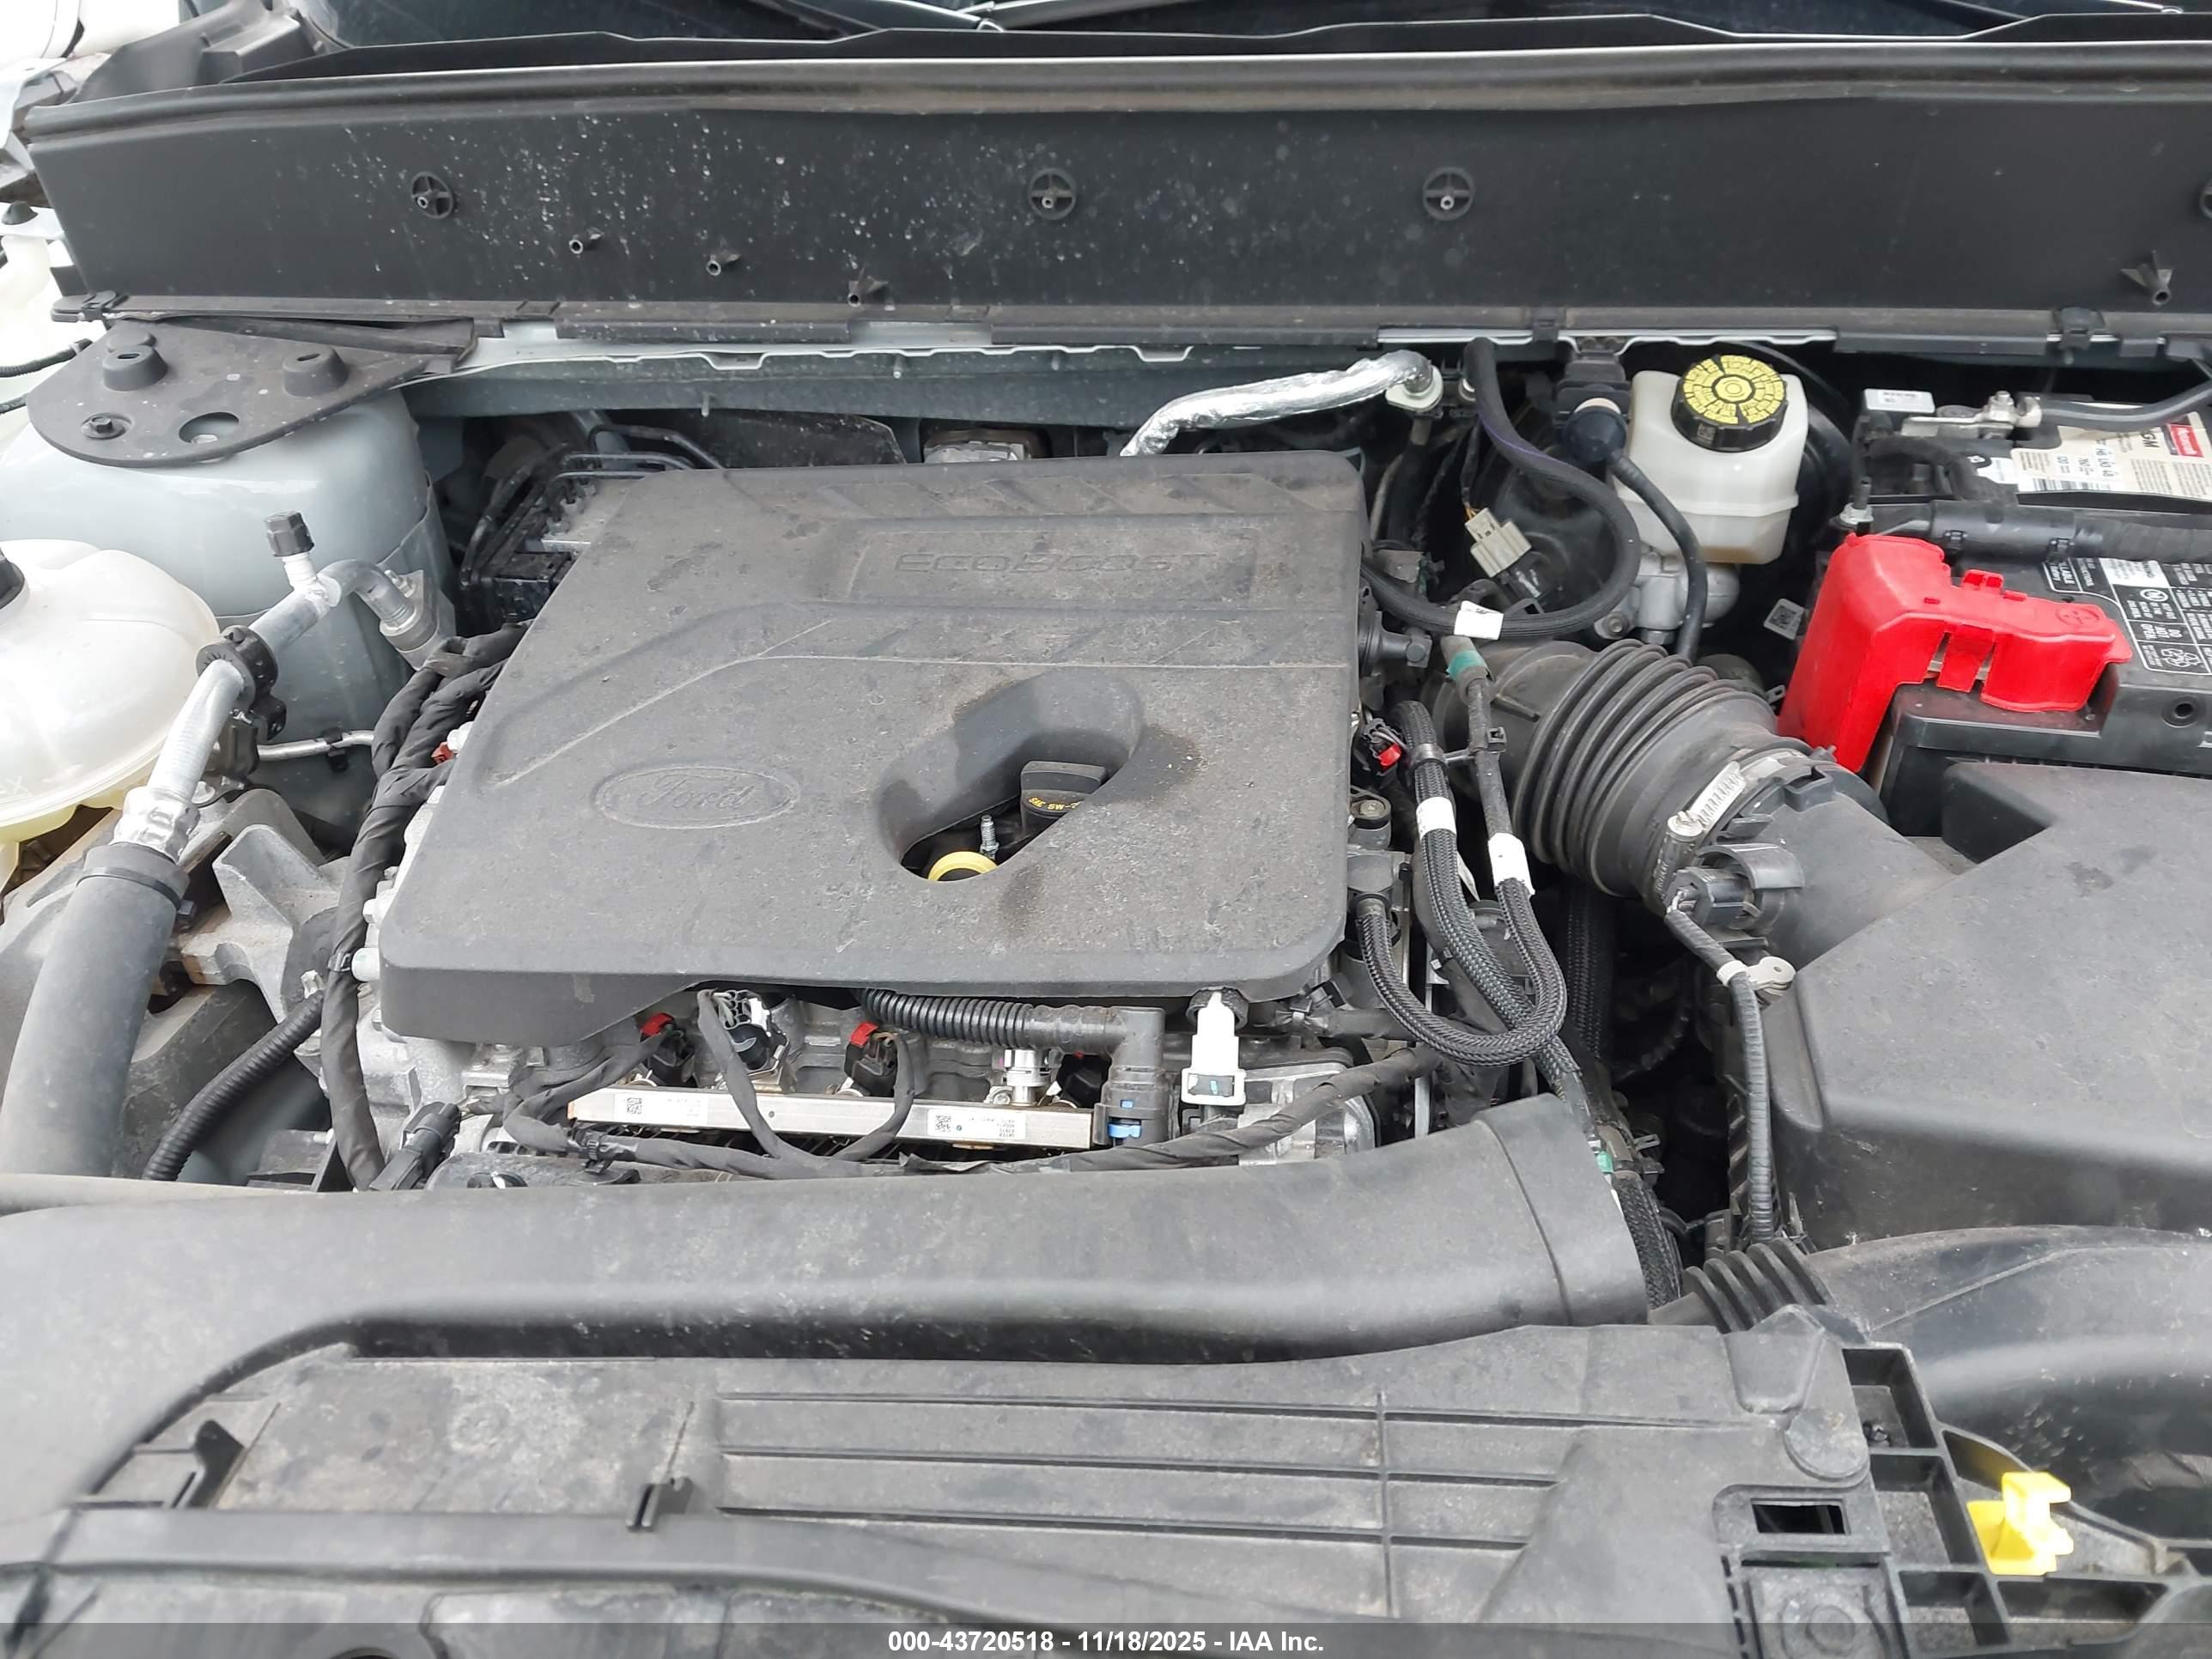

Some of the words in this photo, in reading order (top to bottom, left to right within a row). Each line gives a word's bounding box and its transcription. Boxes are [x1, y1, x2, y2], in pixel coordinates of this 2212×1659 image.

[2140, 624, 2158, 640] OPEN.
[2154, 627, 2171, 639] NOT
[2167, 629, 2184, 638] DO
[636, 774, 756, 809] Ford
[1028, 797, 1047, 808] SAE
[1047, 800, 1083, 811] 5W-2
